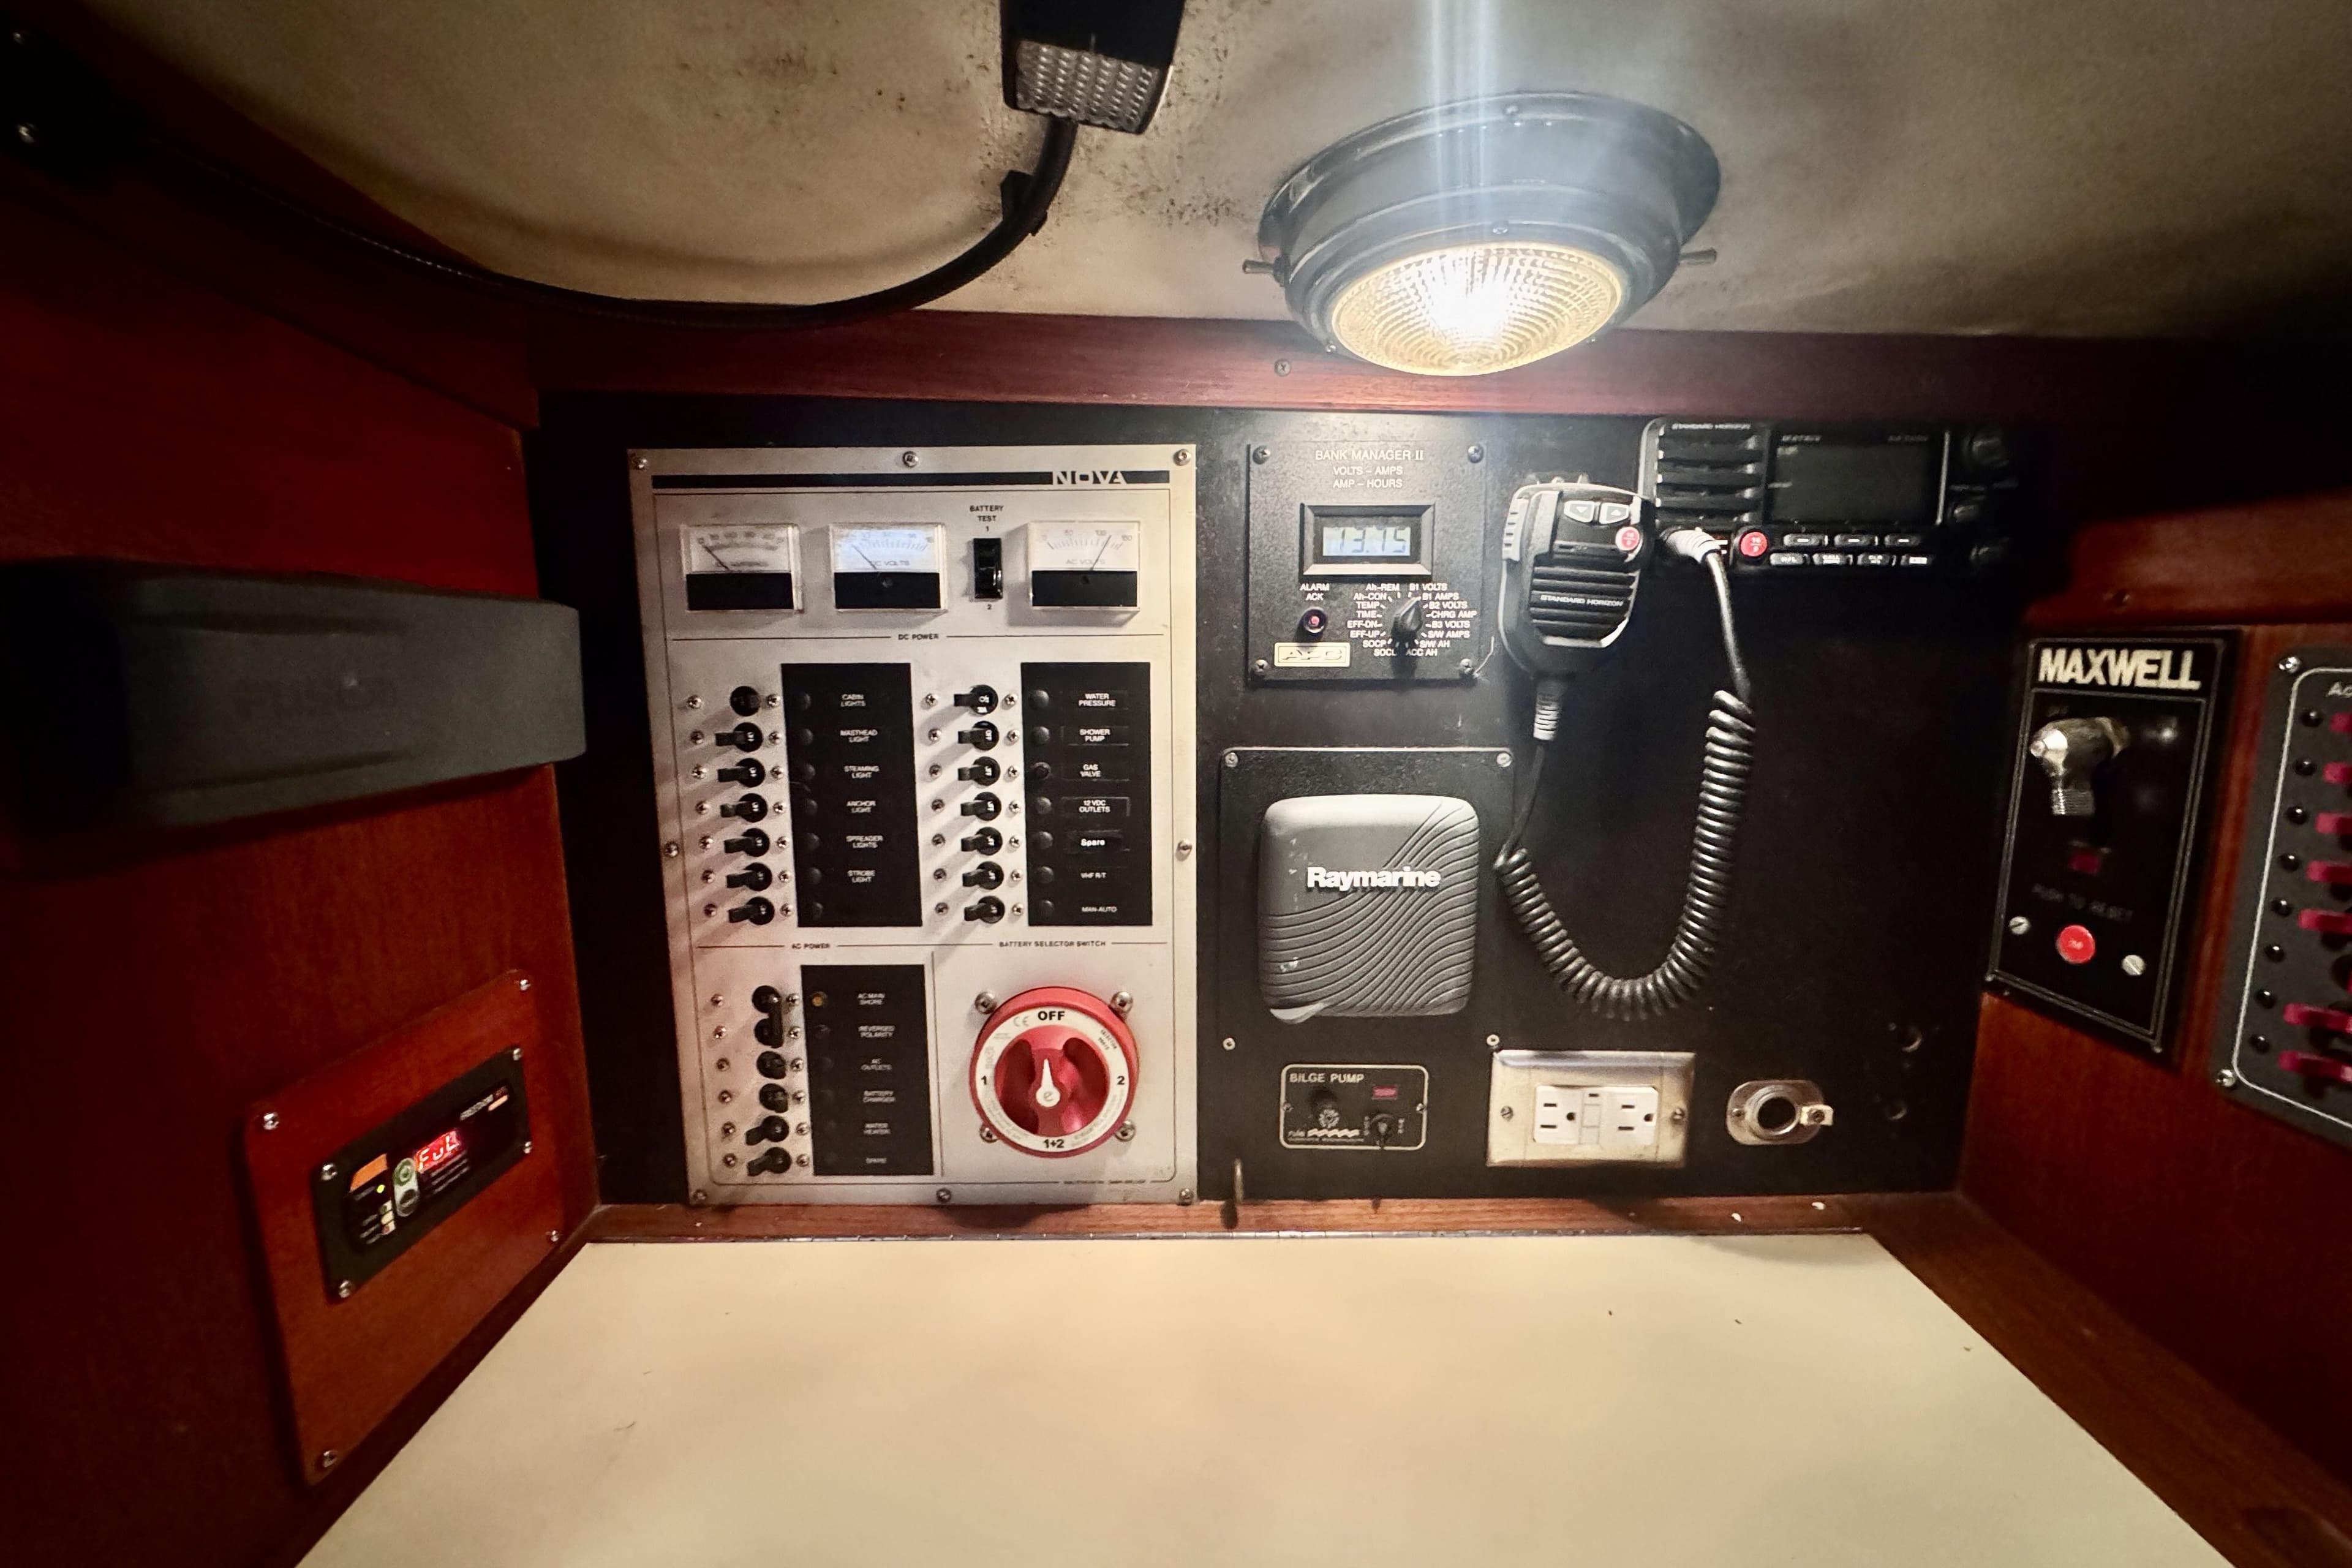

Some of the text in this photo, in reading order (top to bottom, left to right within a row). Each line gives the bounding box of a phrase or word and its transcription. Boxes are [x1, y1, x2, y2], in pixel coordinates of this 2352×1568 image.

[1314, 448, 1424, 461] BANK MANAGER II
[1333, 466, 1363, 475] VOLTS
[1374, 466, 1403, 475] AMPS
[1053, 470, 1127, 484] NOVA
[1333, 478, 1355, 488] AMP
[1366, 478, 1403, 488] HOURS
[1299, 582, 1330, 592] ALARM
[1408, 582, 1448, 593] B1 VOLTS
[1305, 592, 1325, 602] ACK
[1422, 592, 1460, 602] B1 AMPS
[1538, 592, 1586, 604] STANDARD
[1355, 601, 1381, 609] TEMP
[1428, 600, 1468, 609] B2 VOLTS
[1355, 609, 1377, 619] TIME
[1431, 610, 1478, 619] CHRG AMP
[1431, 620, 1471, 628] B3 VOLTS
[1427, 630, 1471, 639] S/W AMPS
[1437, 639, 1450, 648] AH
[1425, 648, 1438, 657] AH
[2037, 647, 2201, 690] MAXWELL
[1079, 728, 1110, 737] SHOWER
[844, 765, 880, 774] STEAMING
[1083, 764, 1100, 772] GAS
[1080, 838, 1106, 847] Spare
[1306, 866, 1441, 891] Raymarine
[1038, 1011, 1065, 1021] OFF
[981, 1076, 988, 1085] 1
[1117, 1076, 1125, 1085] 2
[1289, 1072, 1365, 1084] BILGE PUMP
[1043, 1139, 1065, 1149] 1+2
